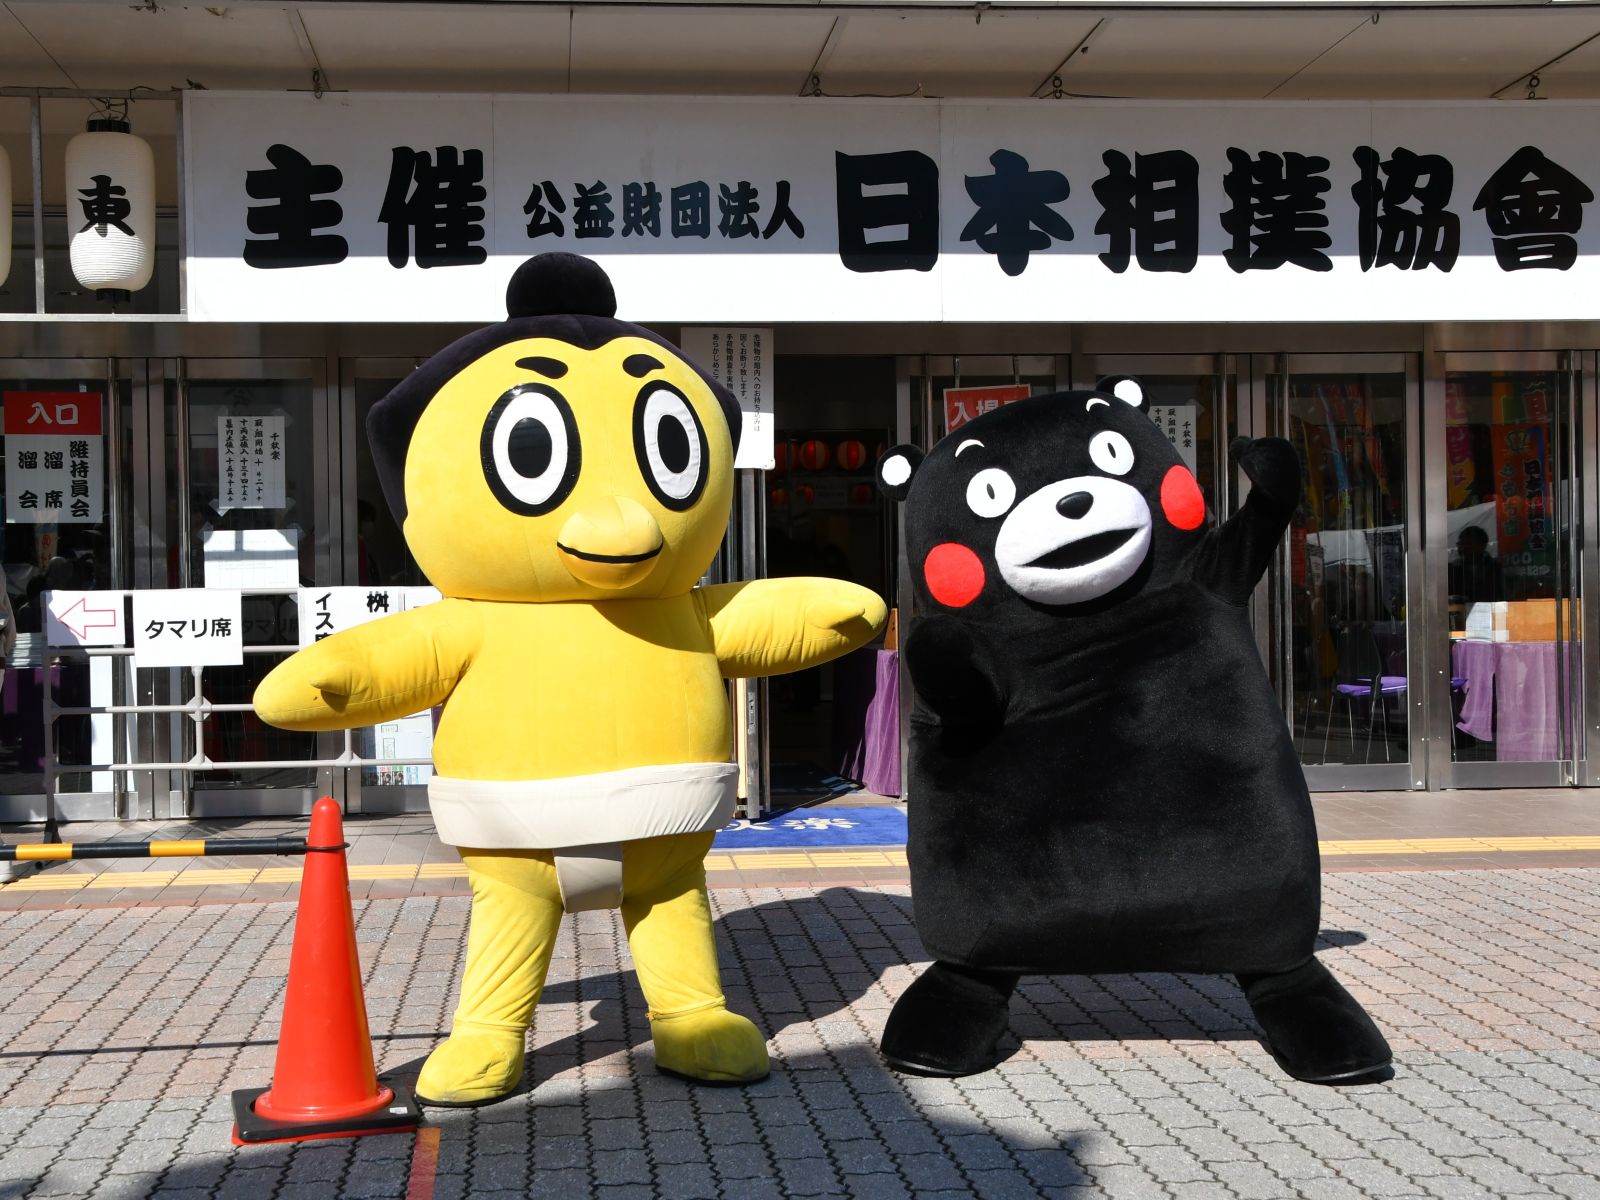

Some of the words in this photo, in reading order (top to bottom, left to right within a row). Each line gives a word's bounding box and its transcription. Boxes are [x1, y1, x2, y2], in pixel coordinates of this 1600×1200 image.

[77, 174, 135, 236] 東
[243, 144, 487, 269] 主催
[523, 180, 804, 239] 公益財団法人
[27, 401, 79, 425] 入口
[69, 440, 90, 518] 維持員会
[366, 590, 390, 613] 桝
[145, 617, 232, 639] タマリ席
